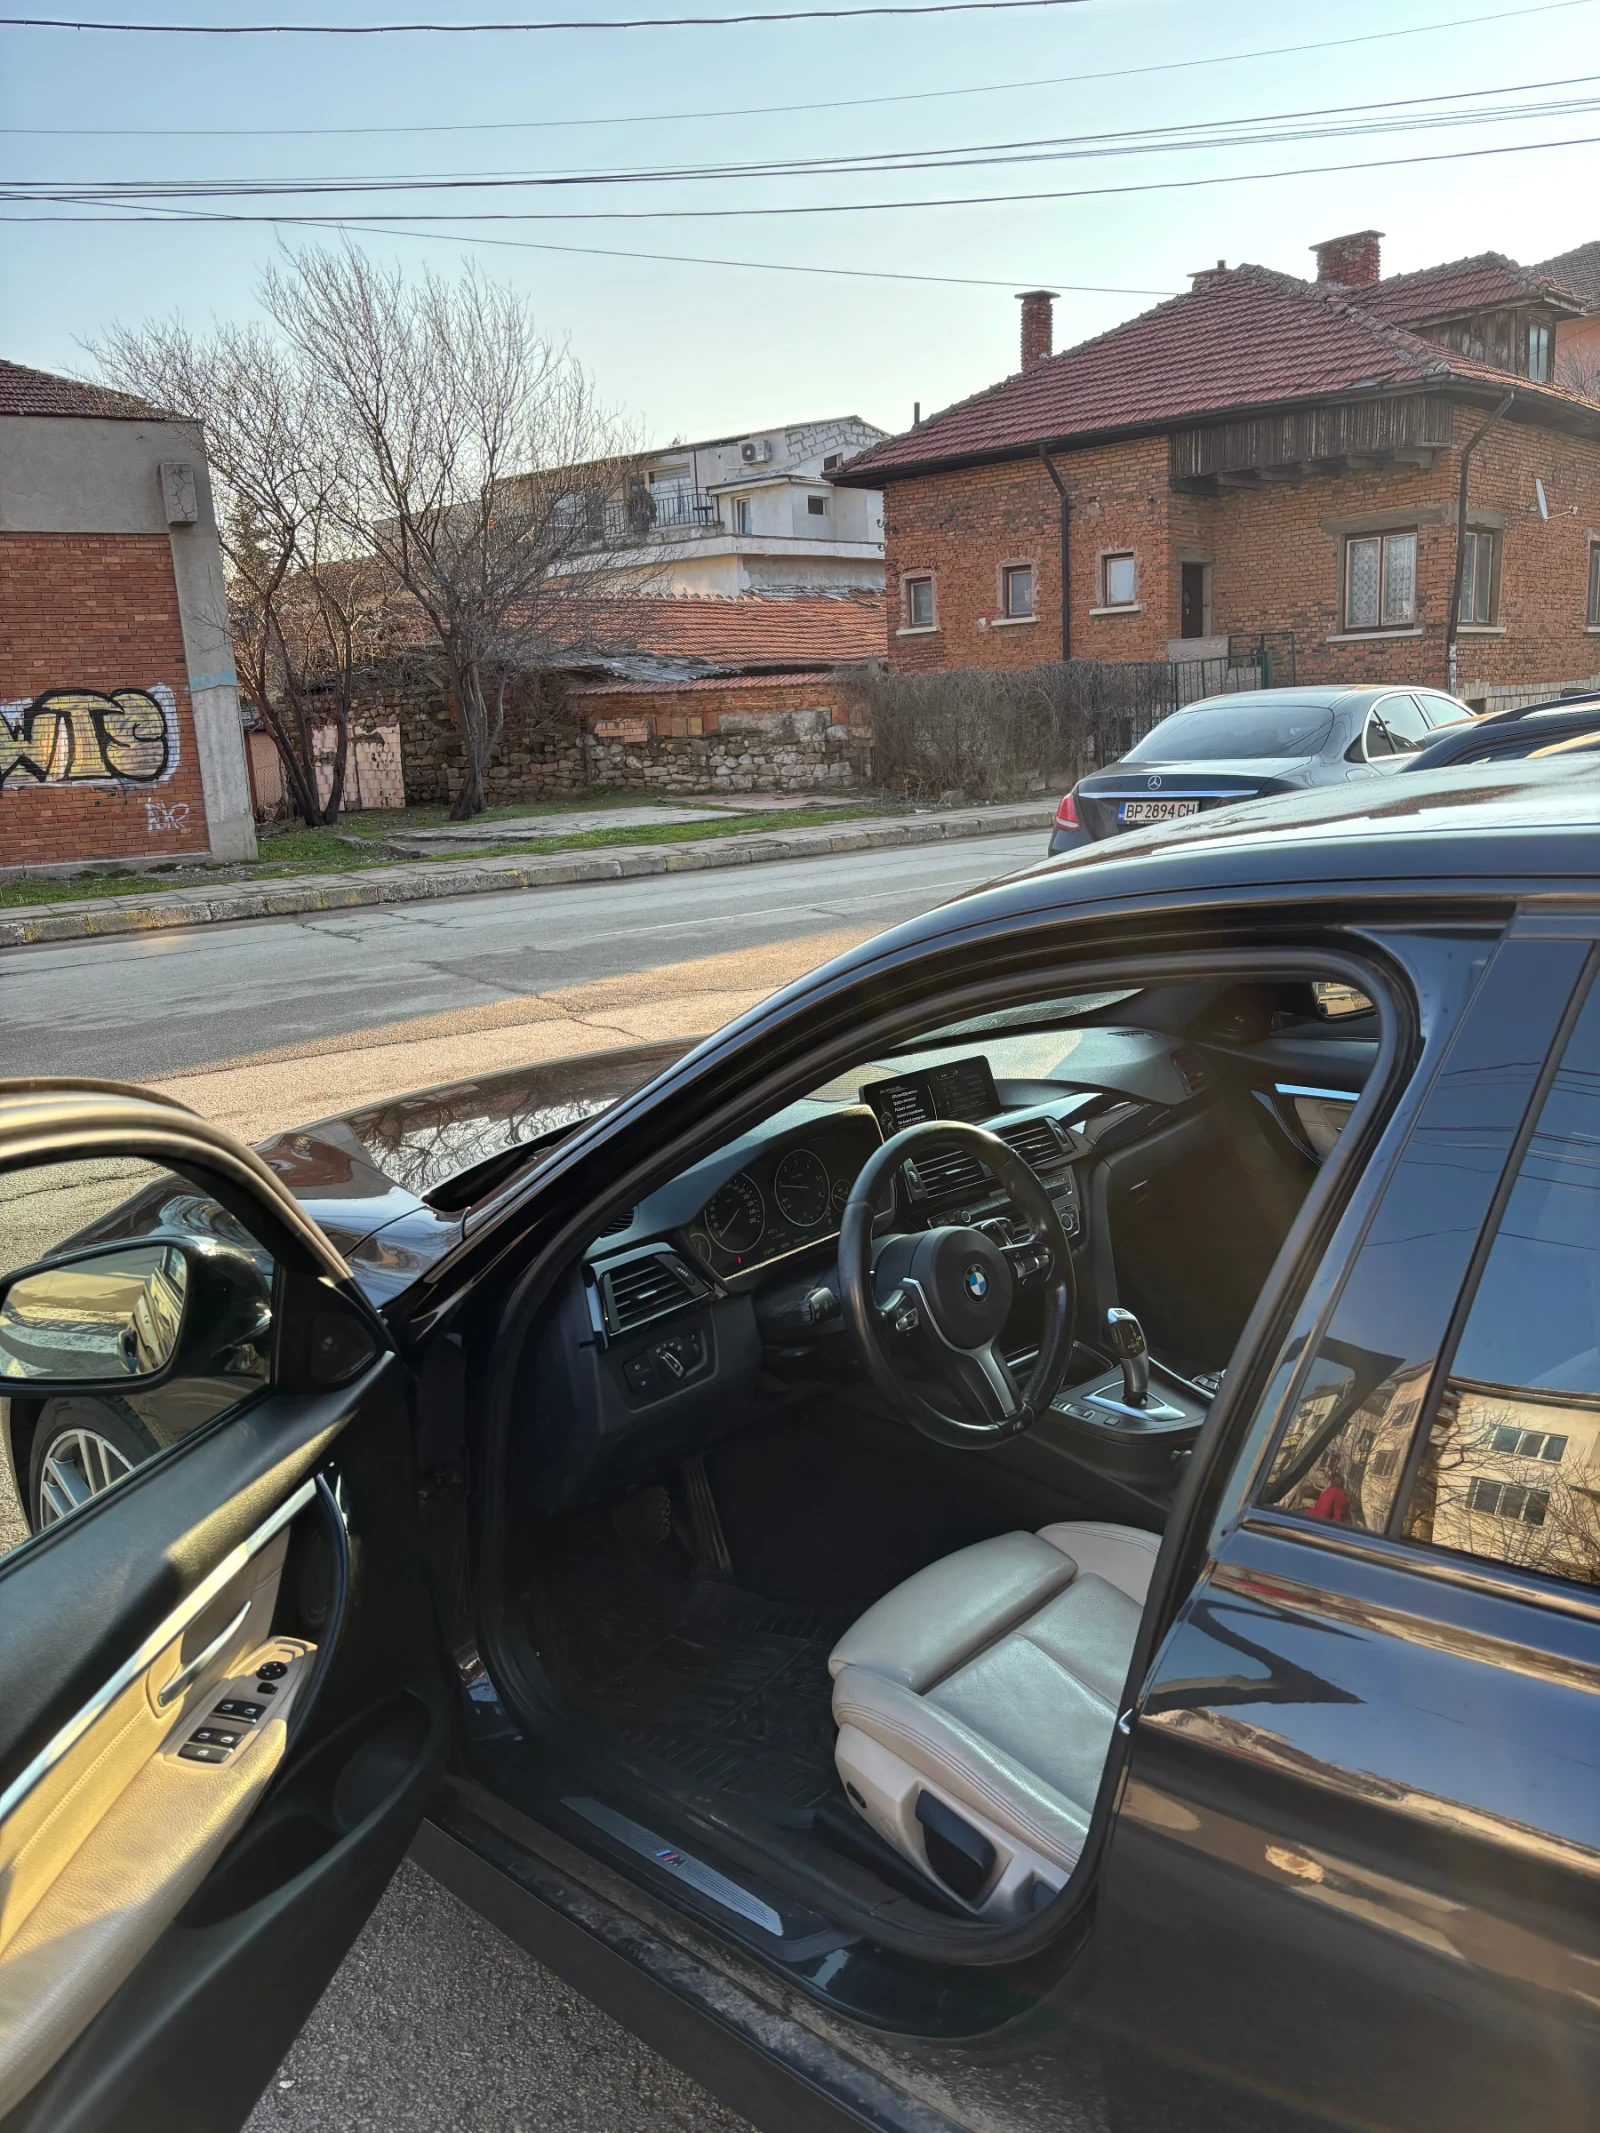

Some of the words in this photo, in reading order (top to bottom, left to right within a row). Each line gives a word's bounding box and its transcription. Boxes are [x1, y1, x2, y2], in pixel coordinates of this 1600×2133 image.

[1126, 804, 1143, 819] BP
[1145, 804, 1175, 819] 2894
[1177, 804, 1196, 818] CH
